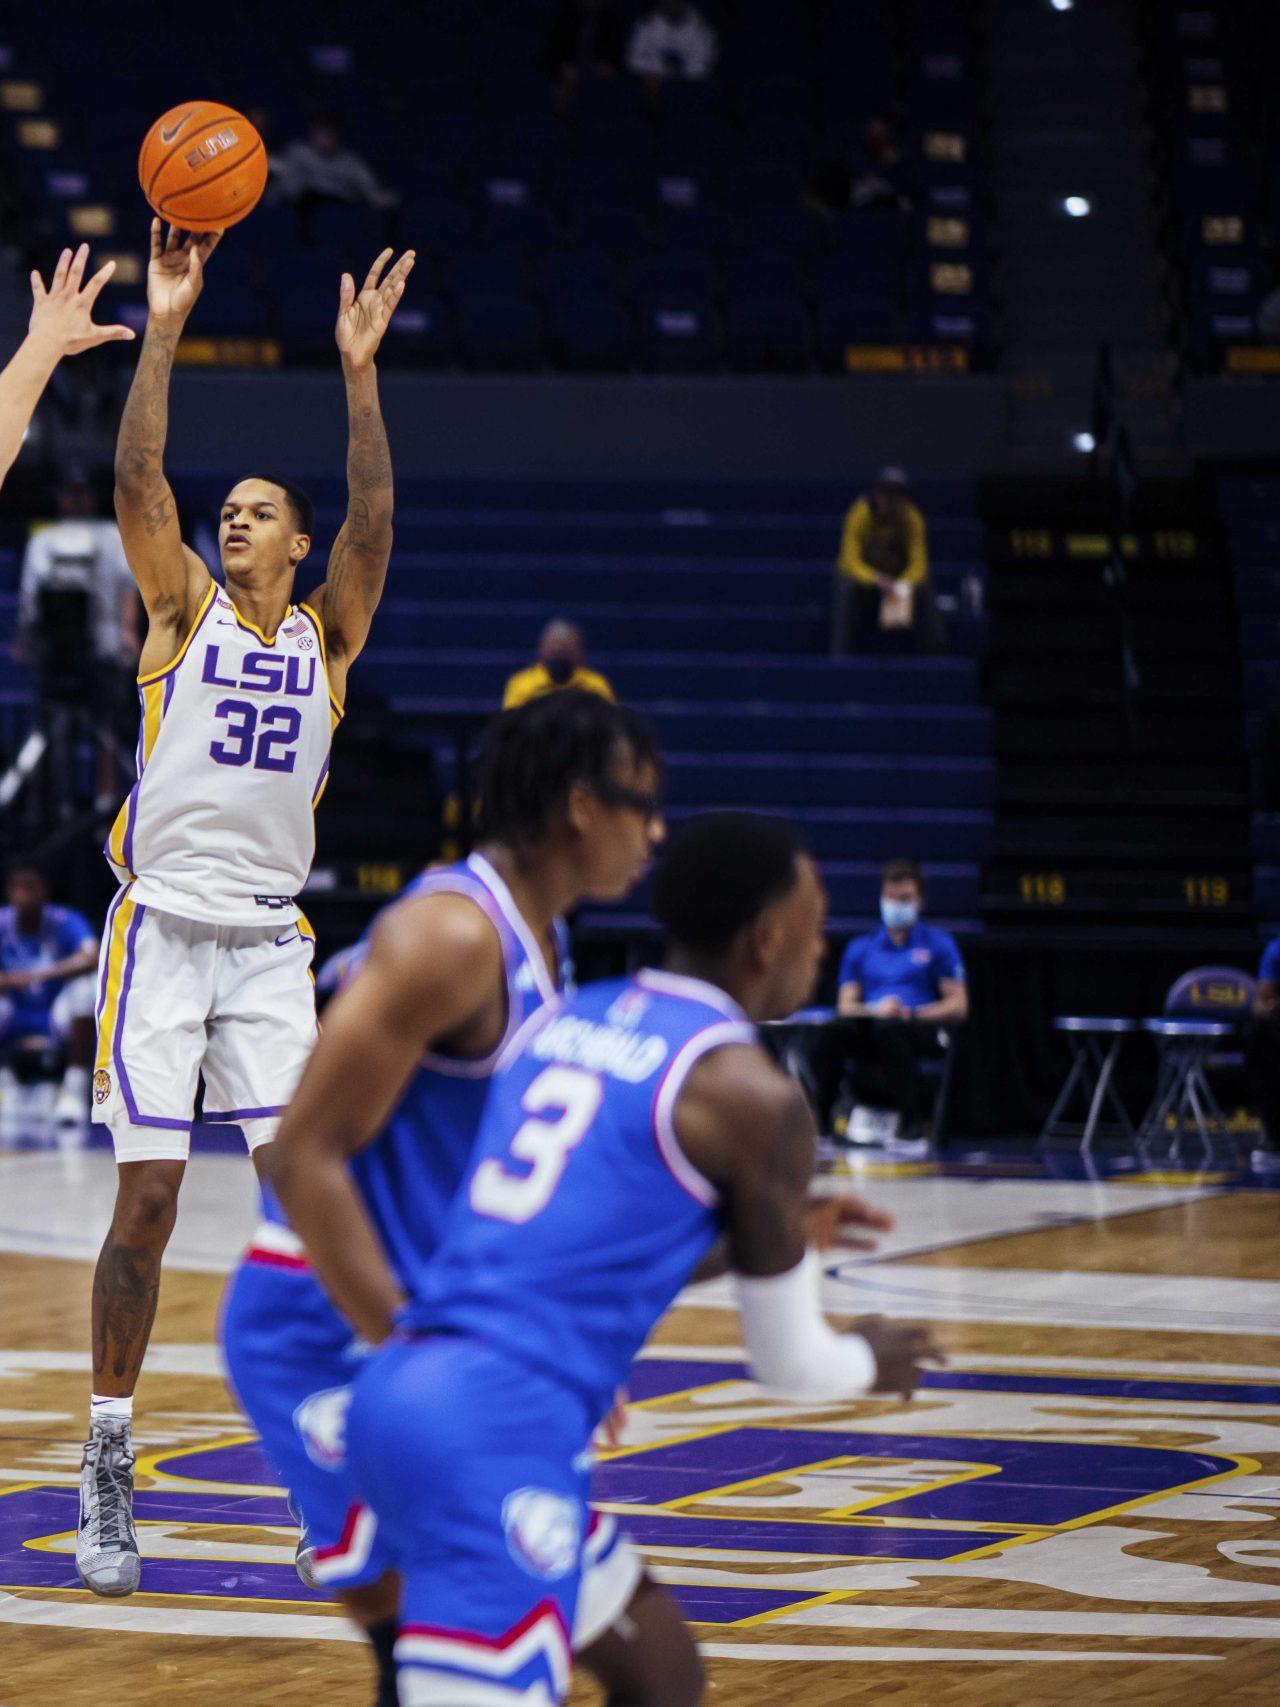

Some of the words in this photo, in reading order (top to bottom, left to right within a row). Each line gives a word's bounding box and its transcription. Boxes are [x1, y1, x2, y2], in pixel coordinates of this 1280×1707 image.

[201, 644, 316, 697] LSU
[209, 698, 303, 773] 32
[468, 1064, 604, 1225] 3
